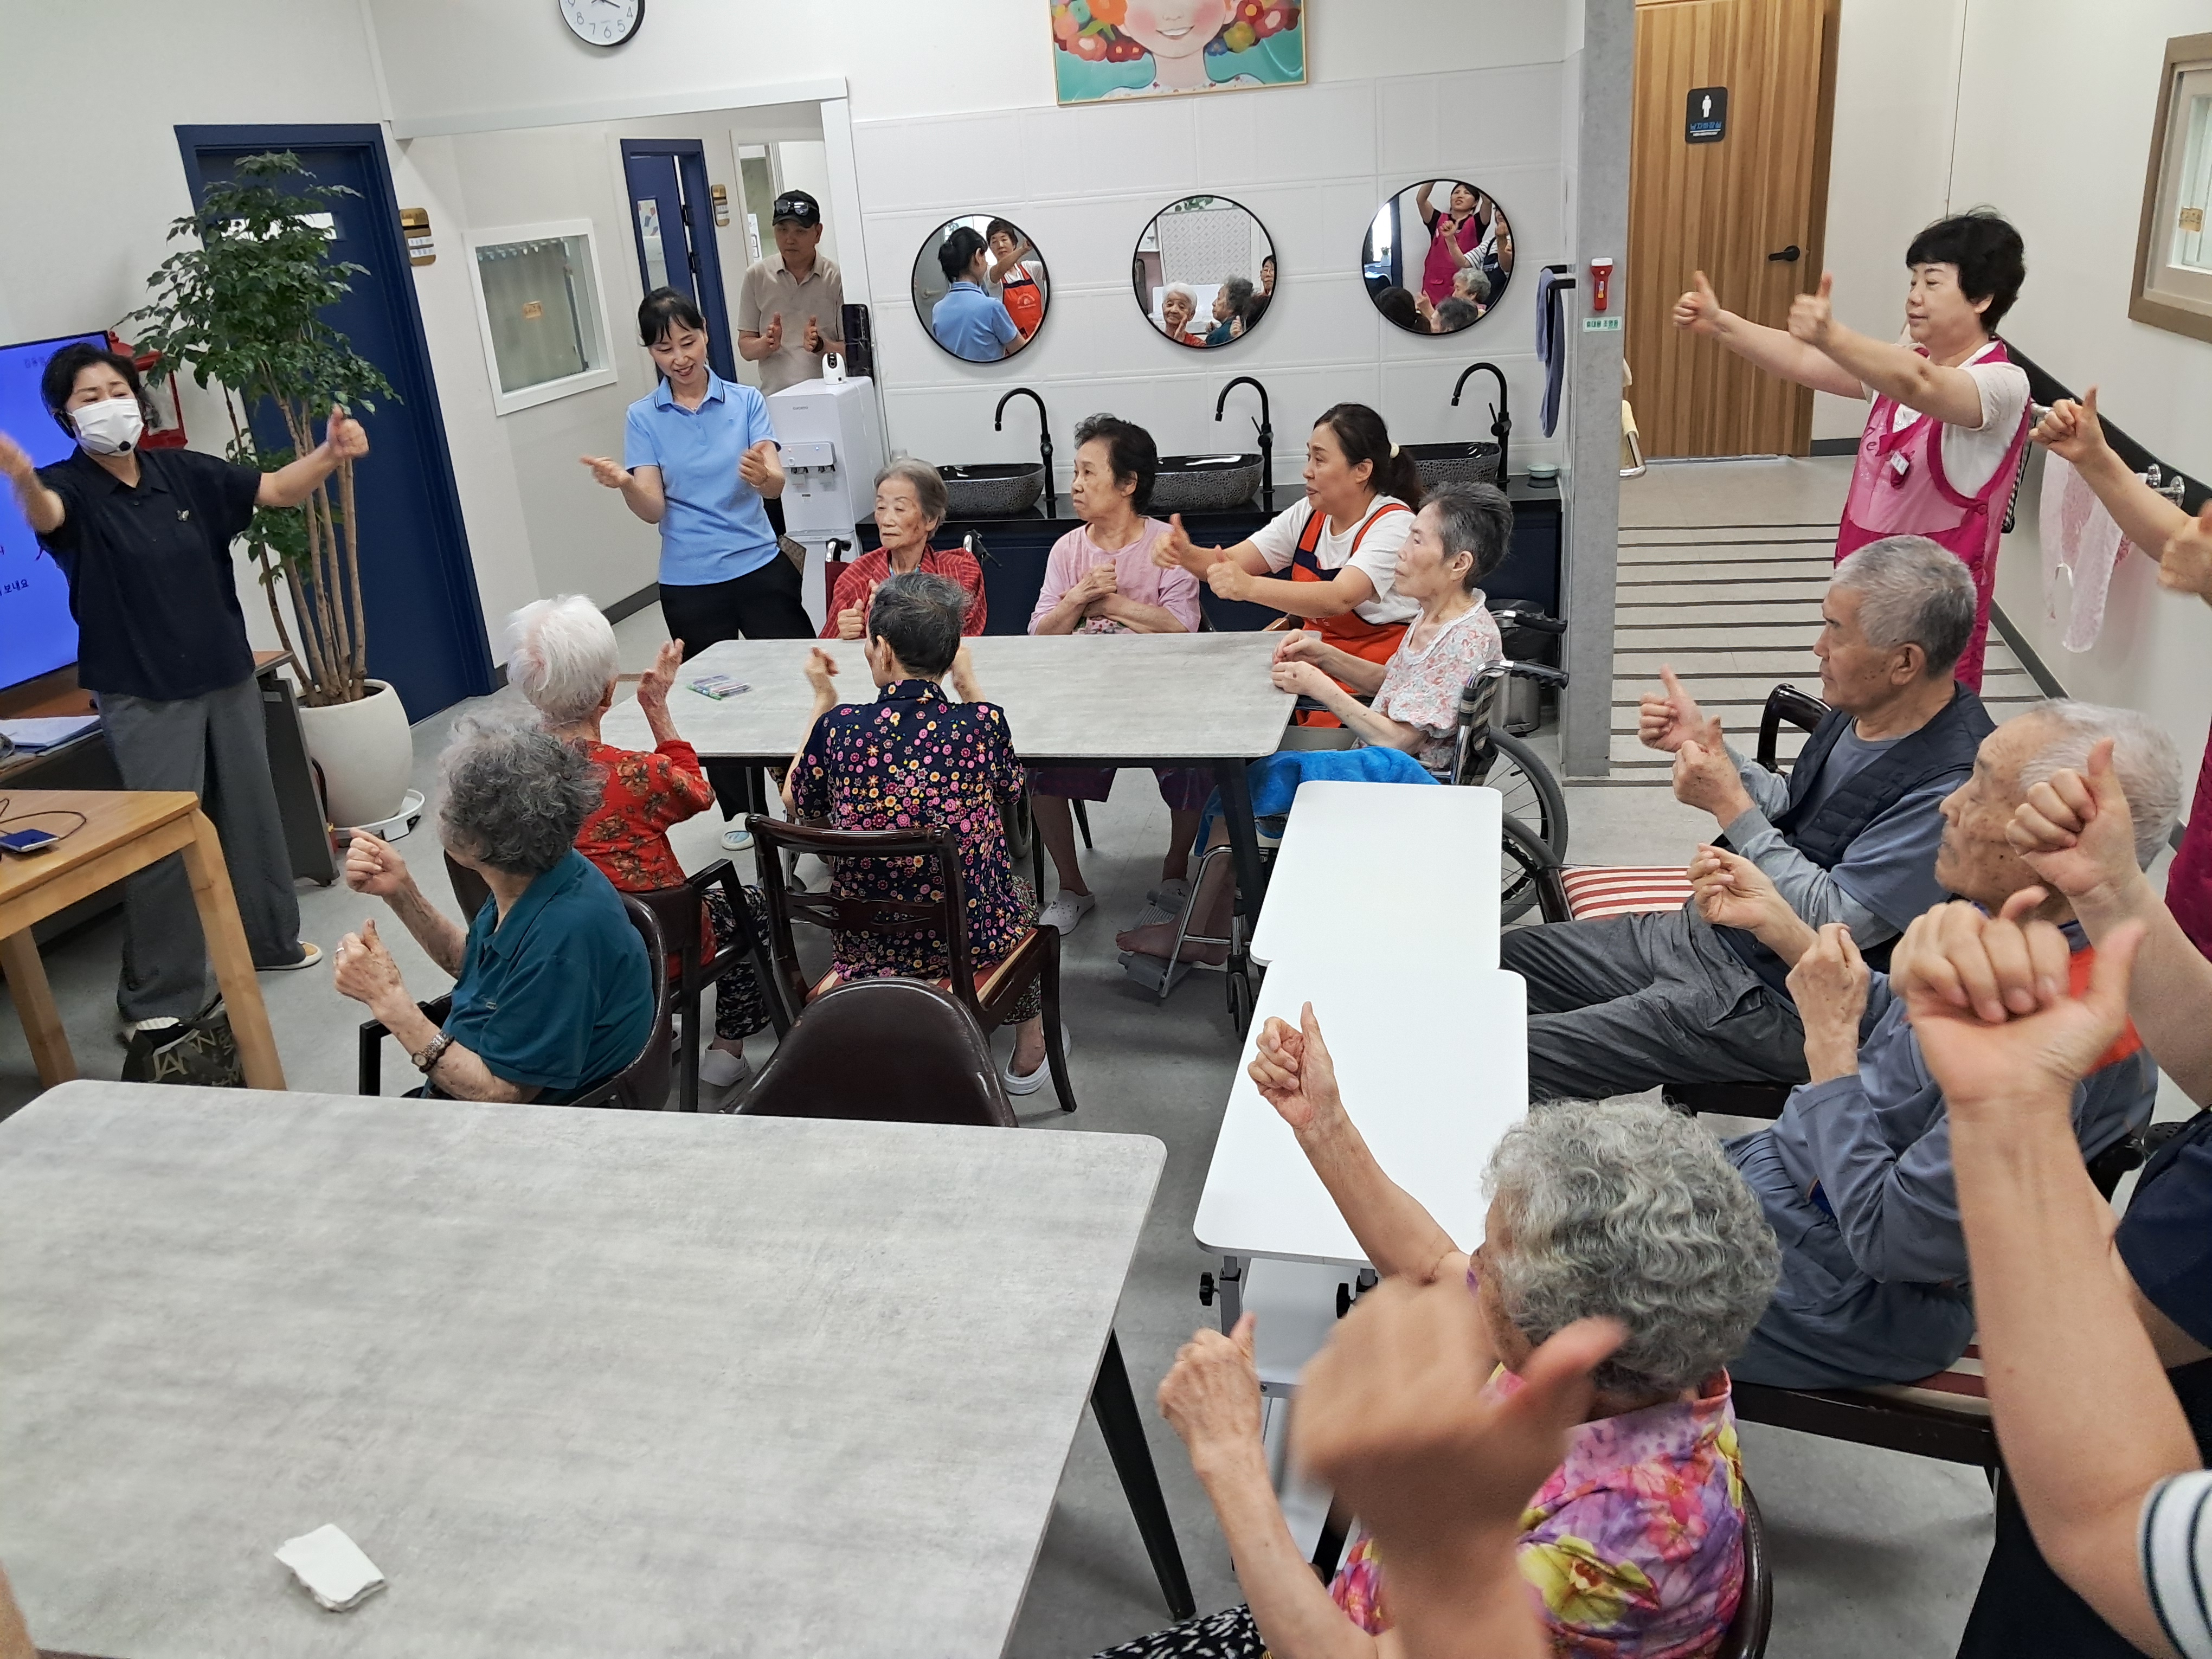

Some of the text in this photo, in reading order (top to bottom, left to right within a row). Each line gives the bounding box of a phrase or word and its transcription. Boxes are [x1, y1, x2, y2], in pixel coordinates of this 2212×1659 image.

[576, 12, 584, 25] 8
[626, 6, 633, 18] 4
[589, 23, 596, 35] 7
[603, 26, 612, 39] 6
[617, 20, 626, 33] 5
[4, 578, 29, 594] 보내요
